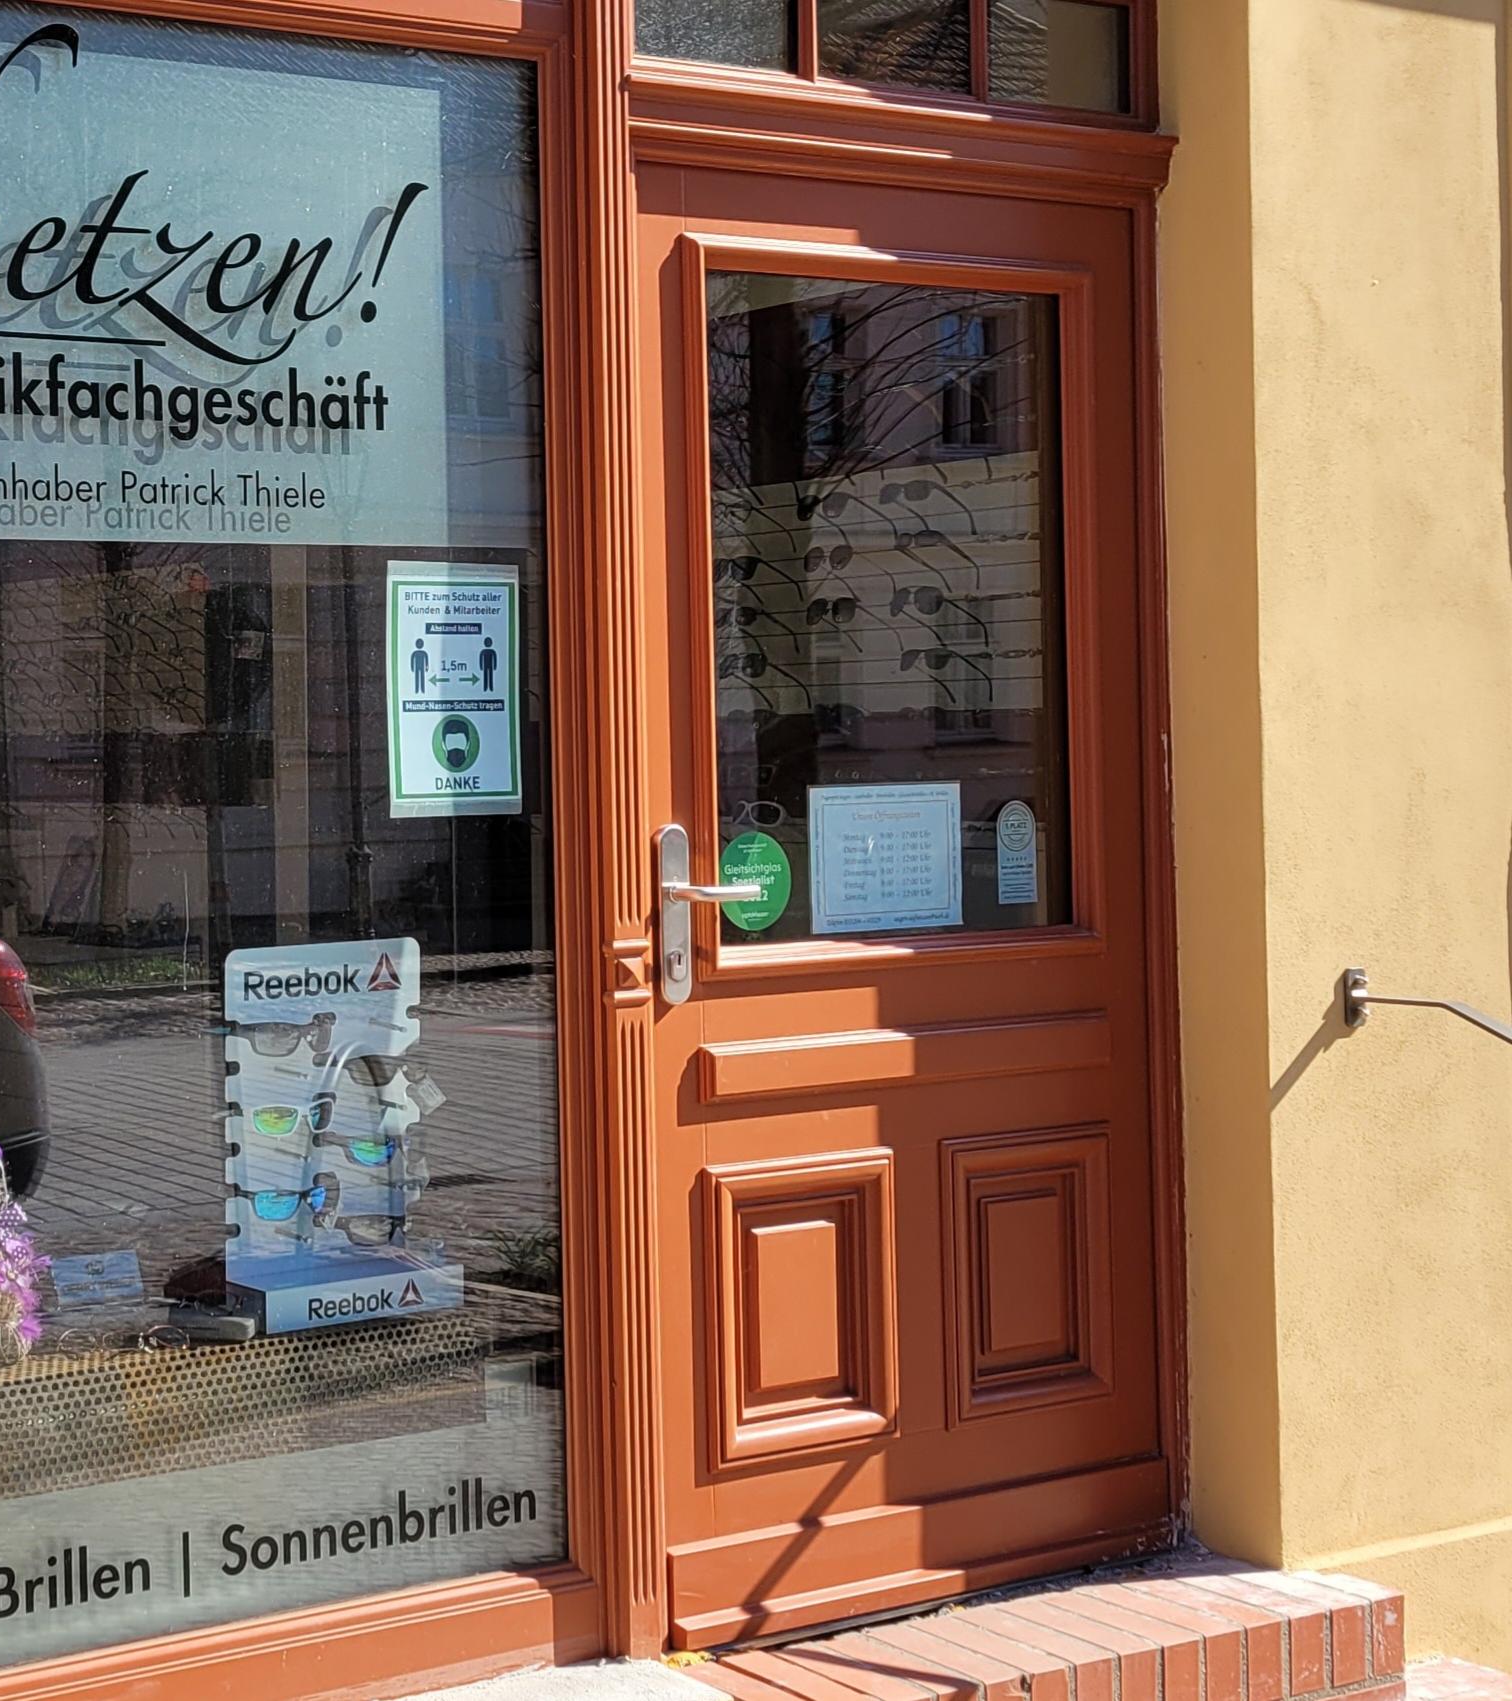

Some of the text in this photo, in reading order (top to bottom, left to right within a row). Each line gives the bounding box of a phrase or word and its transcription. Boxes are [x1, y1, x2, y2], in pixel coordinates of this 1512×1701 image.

[121, 470, 226, 508] Patrick
[237, 474, 327, 510] Thiele
[405, 591, 430, 601] BITTE
[451, 592, 480, 602] Schutz
[481, 592, 502, 602] aller
[408, 605, 501, 615] Kunden & Mitarbeiter
[430, 625, 479, 633] Abstand halten
[441, 660, 467, 673] 1,5m
[405, 701, 503, 711] Mund-Nasen-Schutz tragen
[435, 776, 481, 791] DANKE
[724, 863, 782, 875] Gleitsichtglas
[243, 964, 362, 1001] Reebok
[307, 1288, 394, 1321] Reebok
[221, 1477, 538, 1577] Sonnenbrillen
